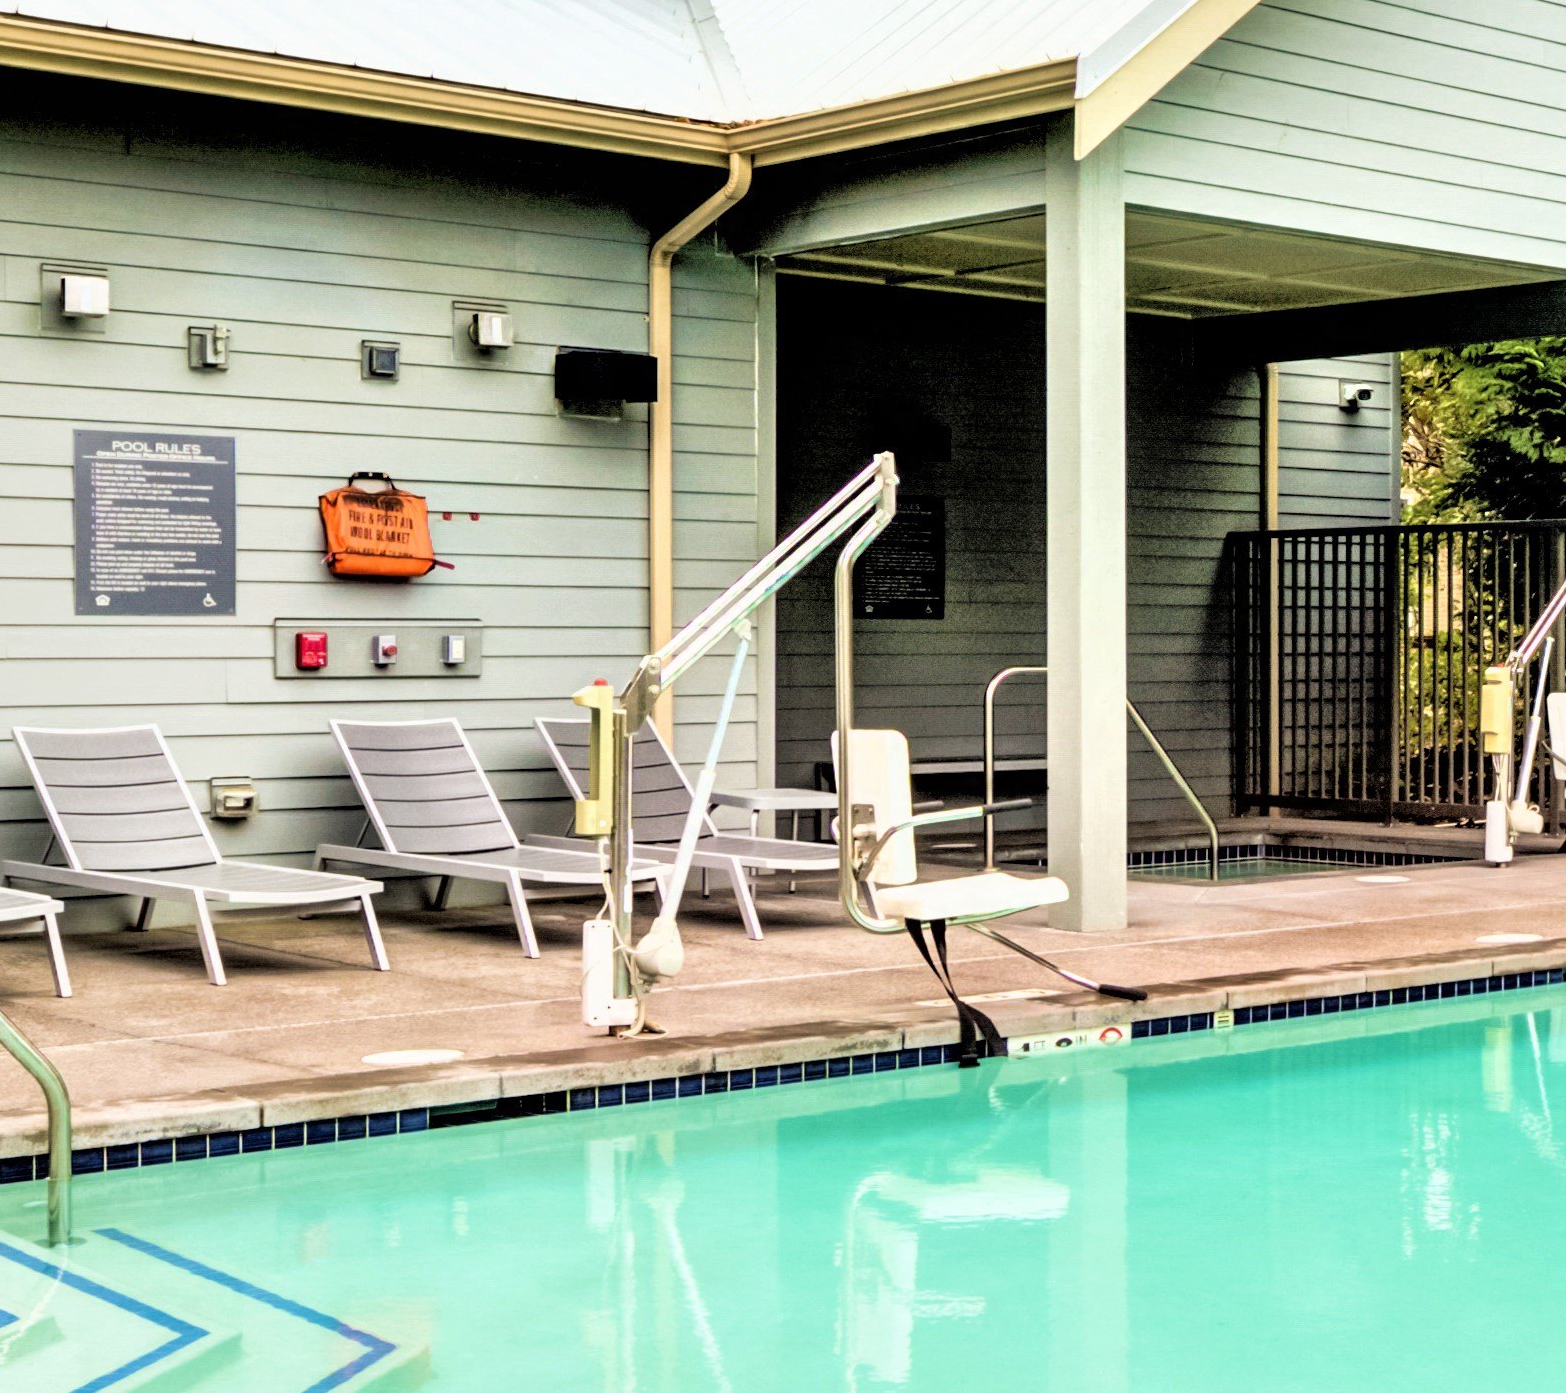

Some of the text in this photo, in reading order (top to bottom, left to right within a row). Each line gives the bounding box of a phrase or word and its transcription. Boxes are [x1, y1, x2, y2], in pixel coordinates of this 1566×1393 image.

[112, 440, 202, 455] POOL RULES
[349, 509, 366, 522] FIRE
[350, 526, 372, 540] WOOL
